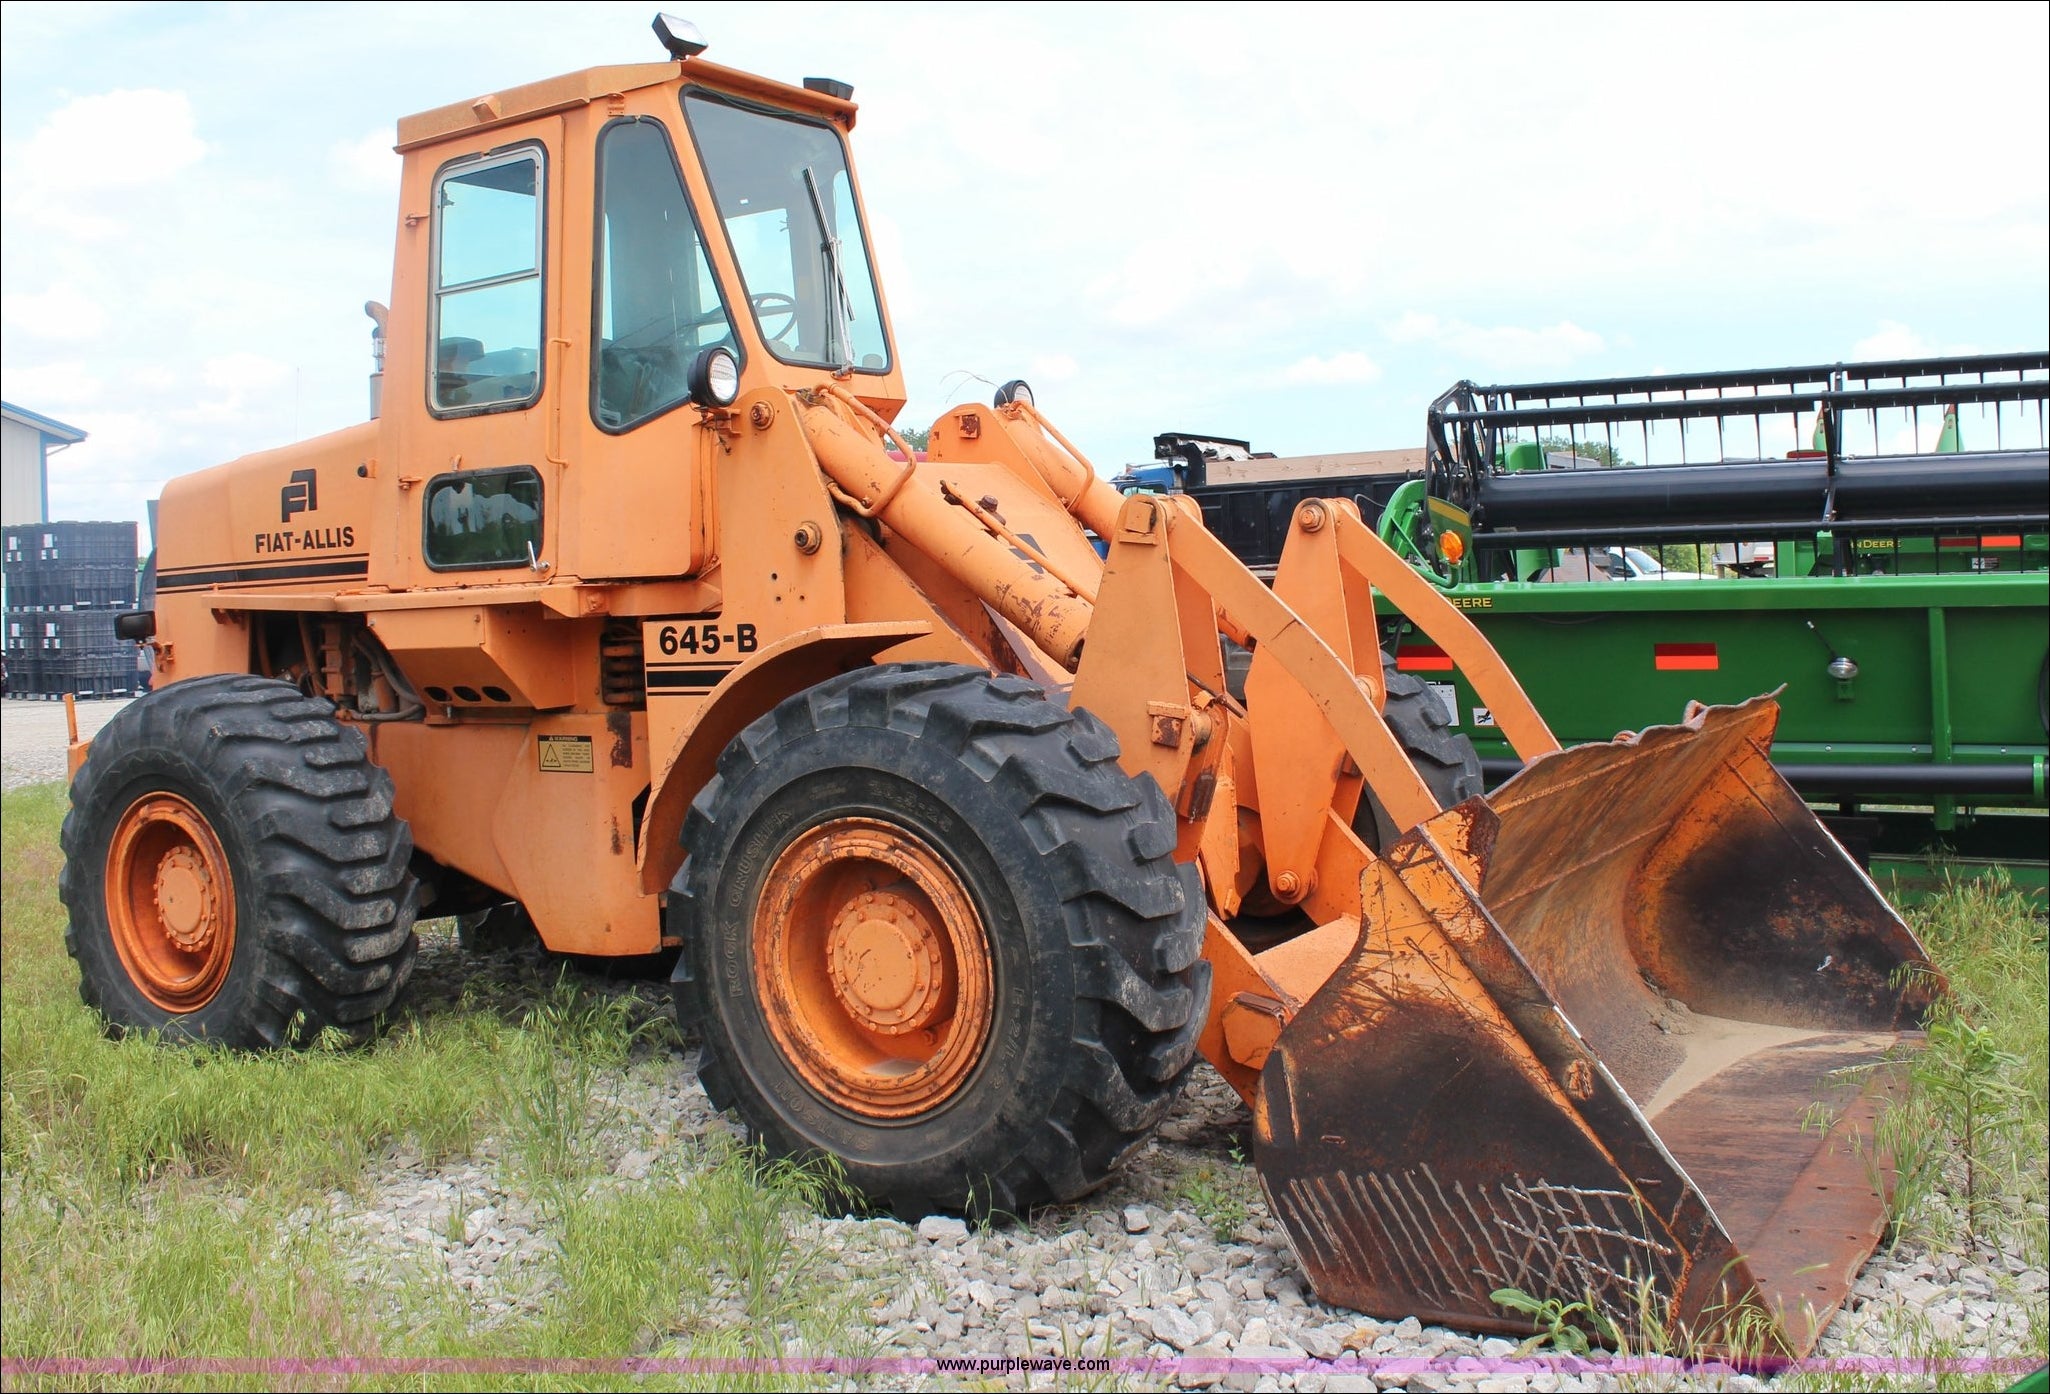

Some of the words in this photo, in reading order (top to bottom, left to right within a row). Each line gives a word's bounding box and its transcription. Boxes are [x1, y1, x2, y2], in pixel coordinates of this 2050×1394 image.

[255, 526, 355, 553] FIAT-ALLIS
[659, 623, 758, 656] 645-B
[730, 806, 793, 908] CRUSHER
[723, 920, 744, 998] ROCK
